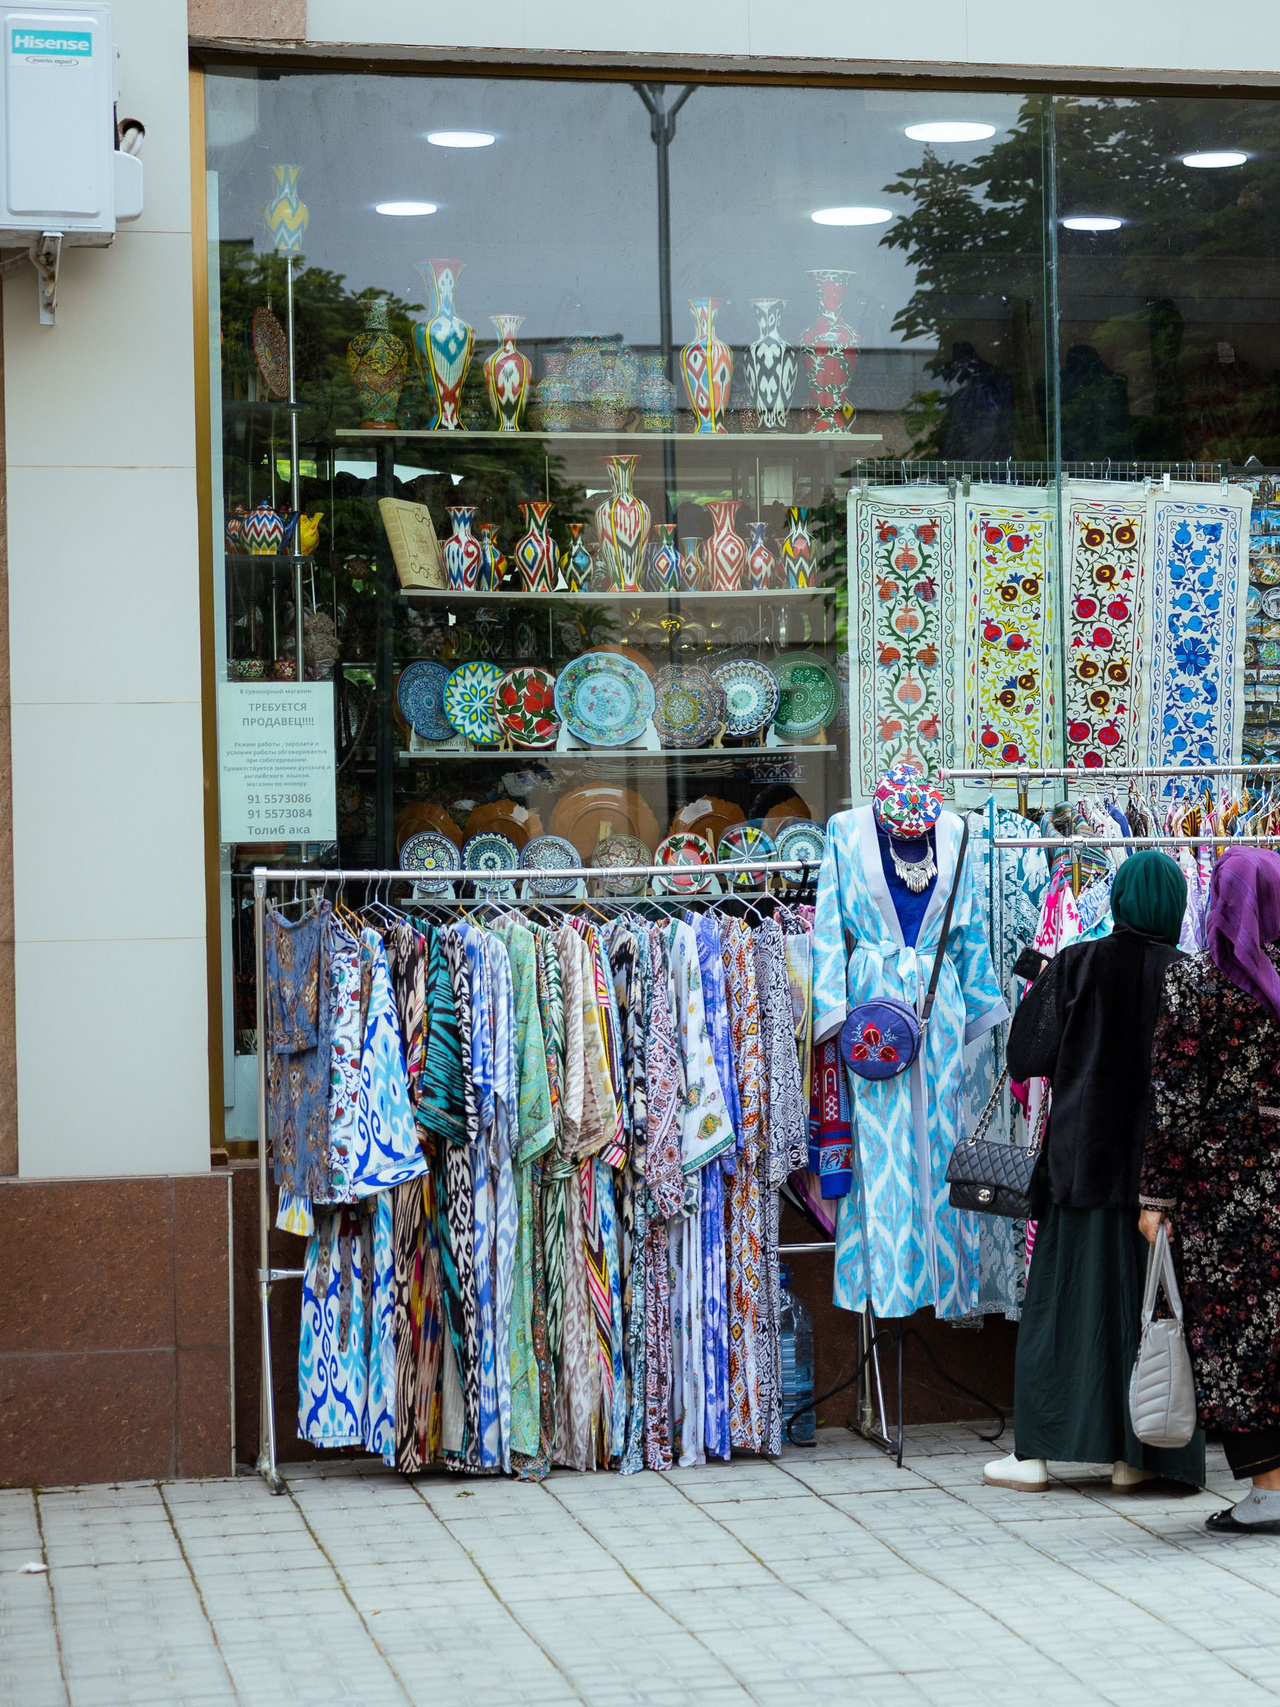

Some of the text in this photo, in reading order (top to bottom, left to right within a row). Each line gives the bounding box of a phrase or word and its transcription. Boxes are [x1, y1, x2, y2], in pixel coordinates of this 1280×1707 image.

[14, 34, 89, 50] Hisense
[249, 703, 307, 712] ТРЕБУЕТСЯ
[242, 717, 314, 728] ПРОДАВЕЦ!!!!
[247, 794, 311, 804] 91 5573086
[248, 809, 312, 819] 91 5573084
[247, 825, 285, 835] Толиб
